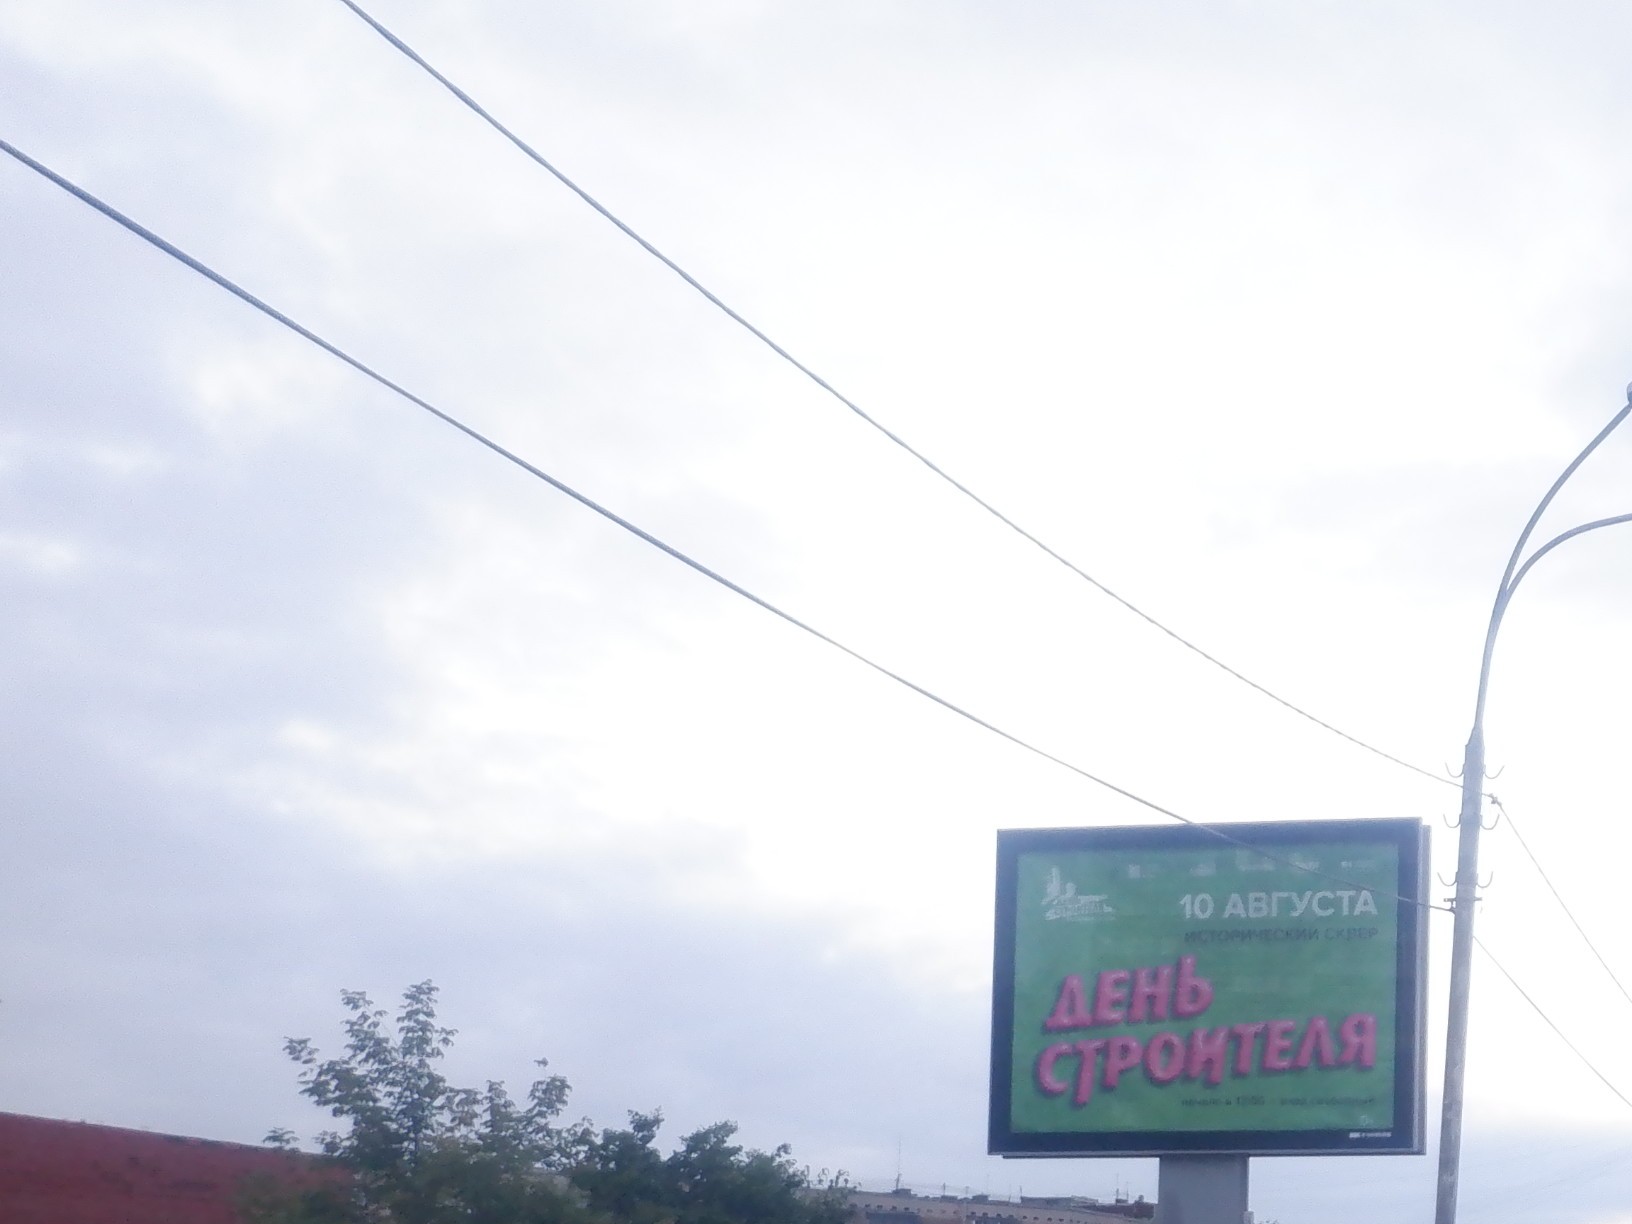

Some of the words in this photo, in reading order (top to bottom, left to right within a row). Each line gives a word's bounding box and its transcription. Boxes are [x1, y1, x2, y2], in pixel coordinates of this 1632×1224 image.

[1179, 892, 1215, 920] 10
[1223, 889, 1379, 919] АВГУСТА
[1043, 954, 1215, 1032] ДЕНЬ
[1035, 1012, 1378, 1109] СТРОИТЕЛЯ
